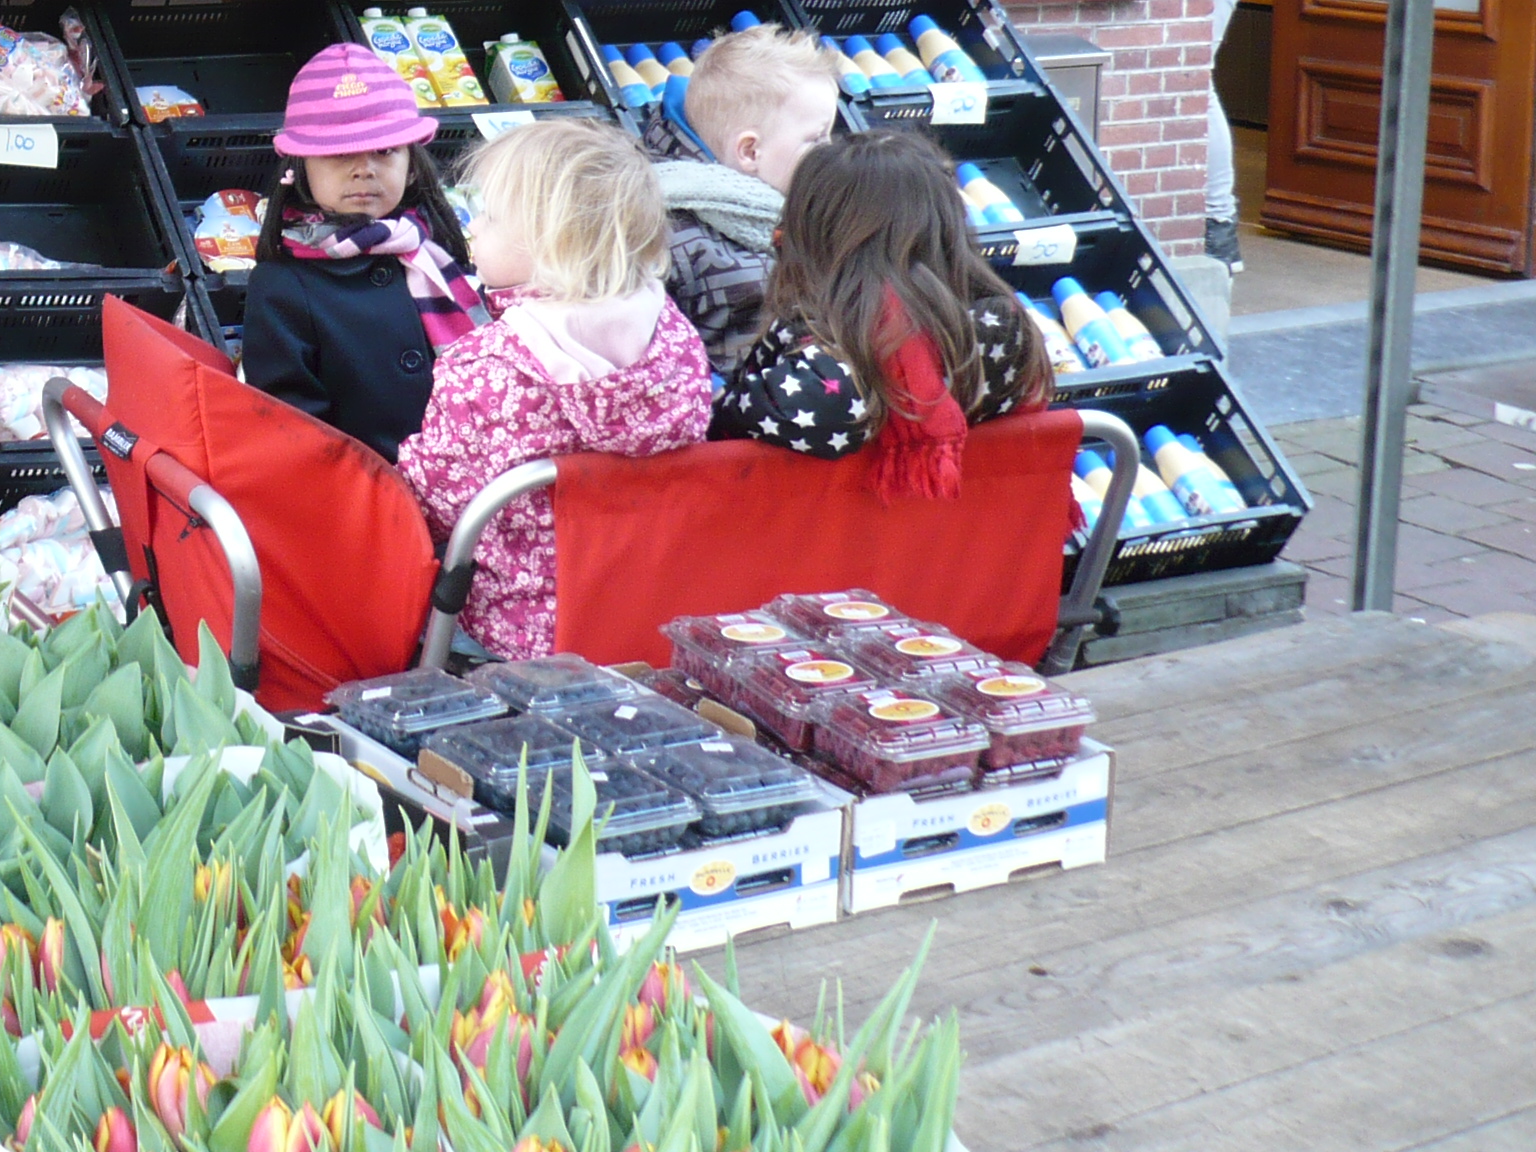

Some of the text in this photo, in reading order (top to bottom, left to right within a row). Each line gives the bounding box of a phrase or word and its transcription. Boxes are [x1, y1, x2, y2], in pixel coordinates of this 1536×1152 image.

[913, 814, 955, 828] FRESH
[630, 873, 676, 889] FRESH
[751, 845, 811, 864] BERRIES
